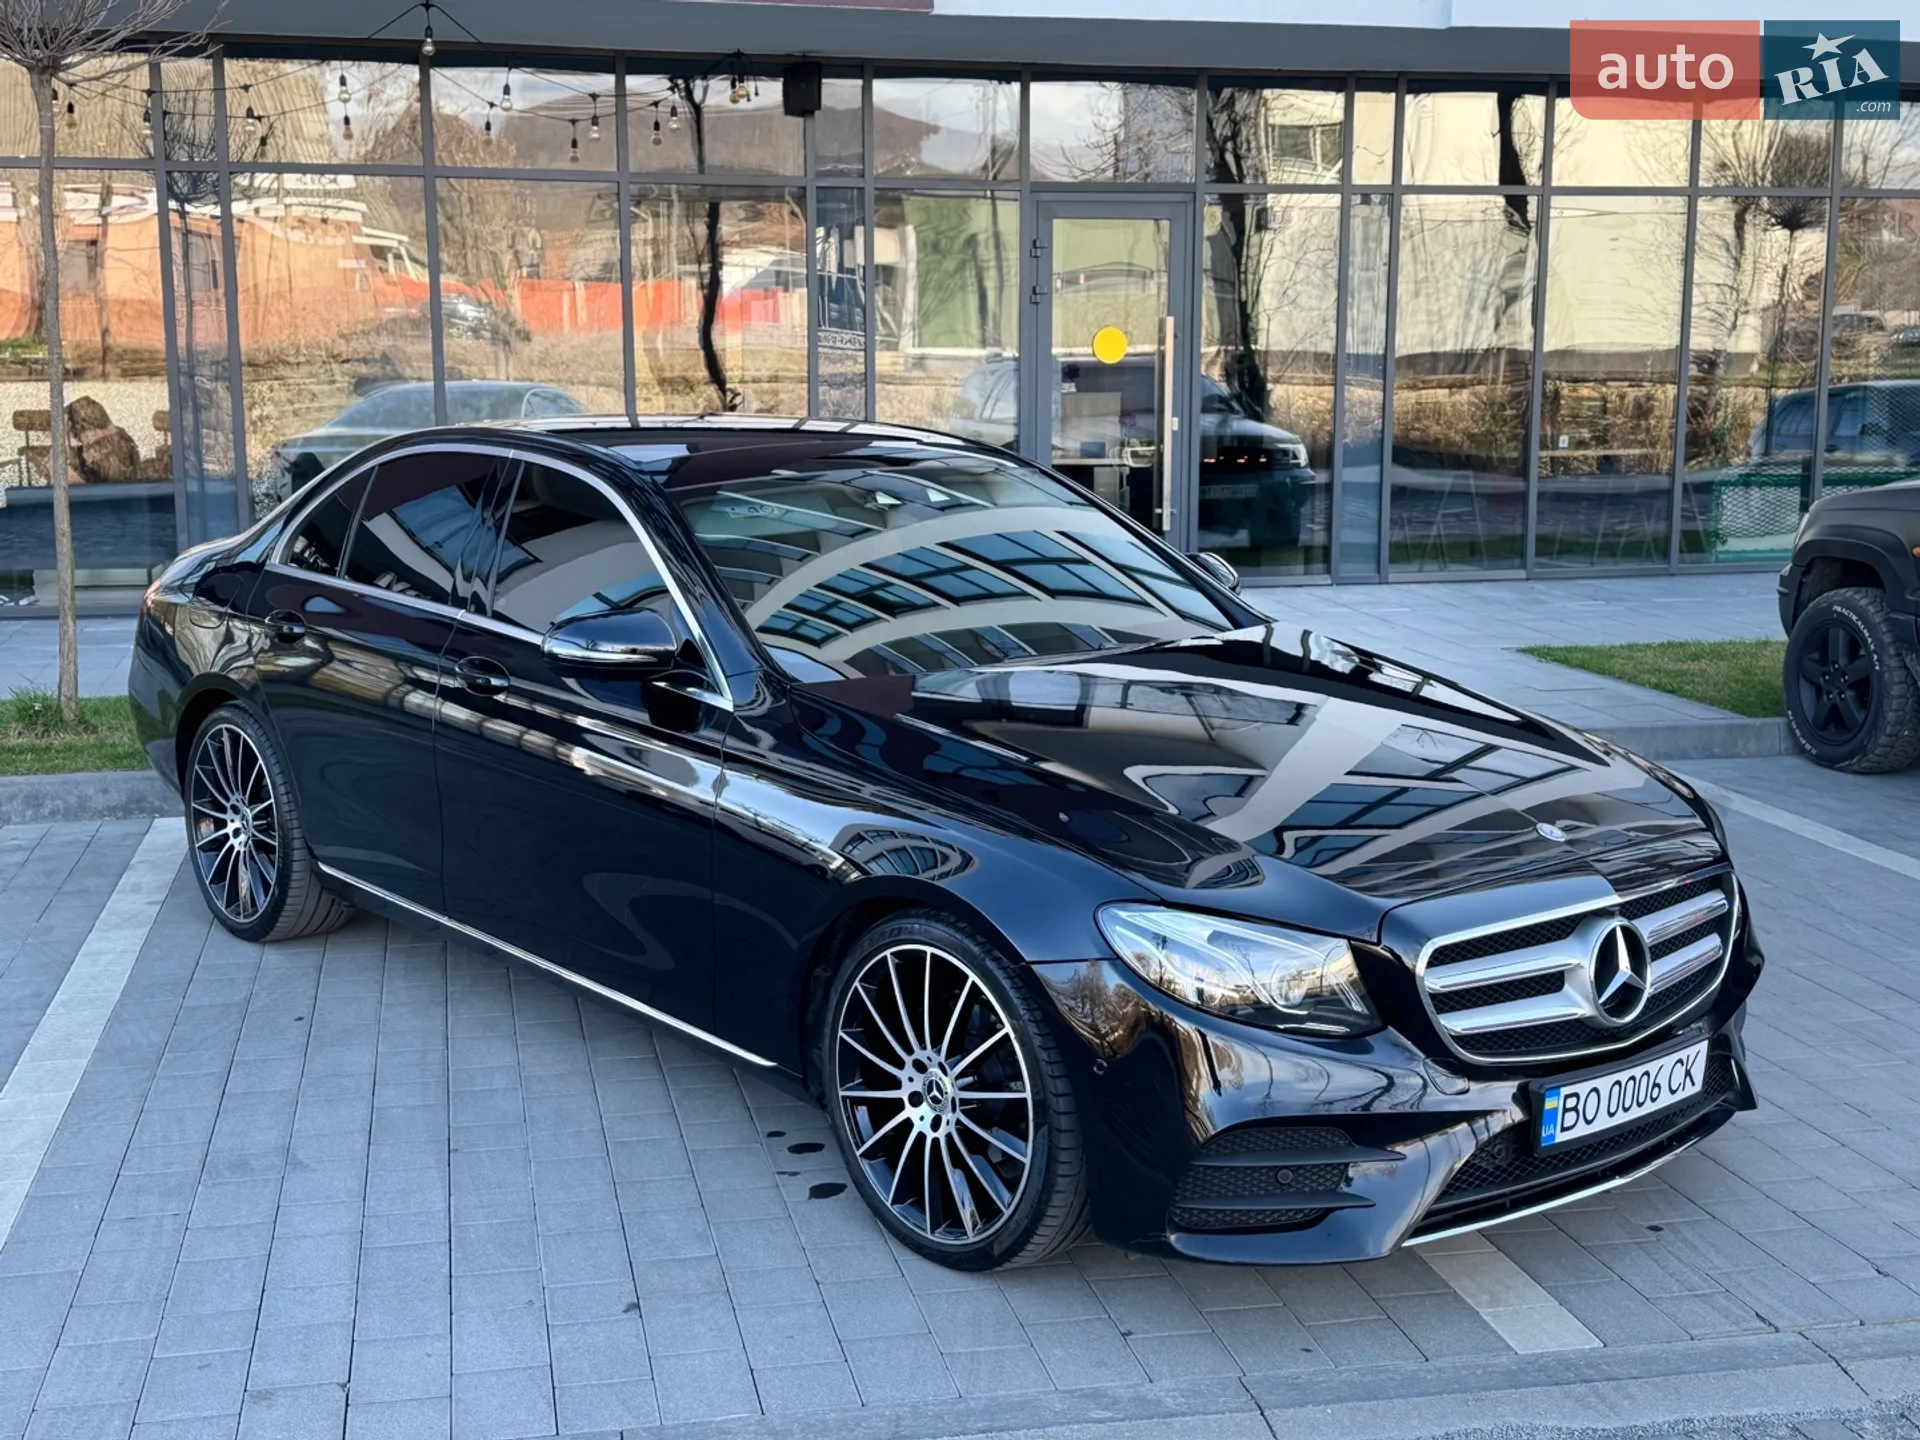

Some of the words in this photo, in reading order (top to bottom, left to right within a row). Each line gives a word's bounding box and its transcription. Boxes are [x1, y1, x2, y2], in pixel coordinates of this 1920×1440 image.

[1560, 1086, 1601, 1133] BO
[1606, 1063, 1664, 1118] 0006
[1668, 1049, 1701, 1096] CK
[1541, 1123, 1555, 1137] UA
